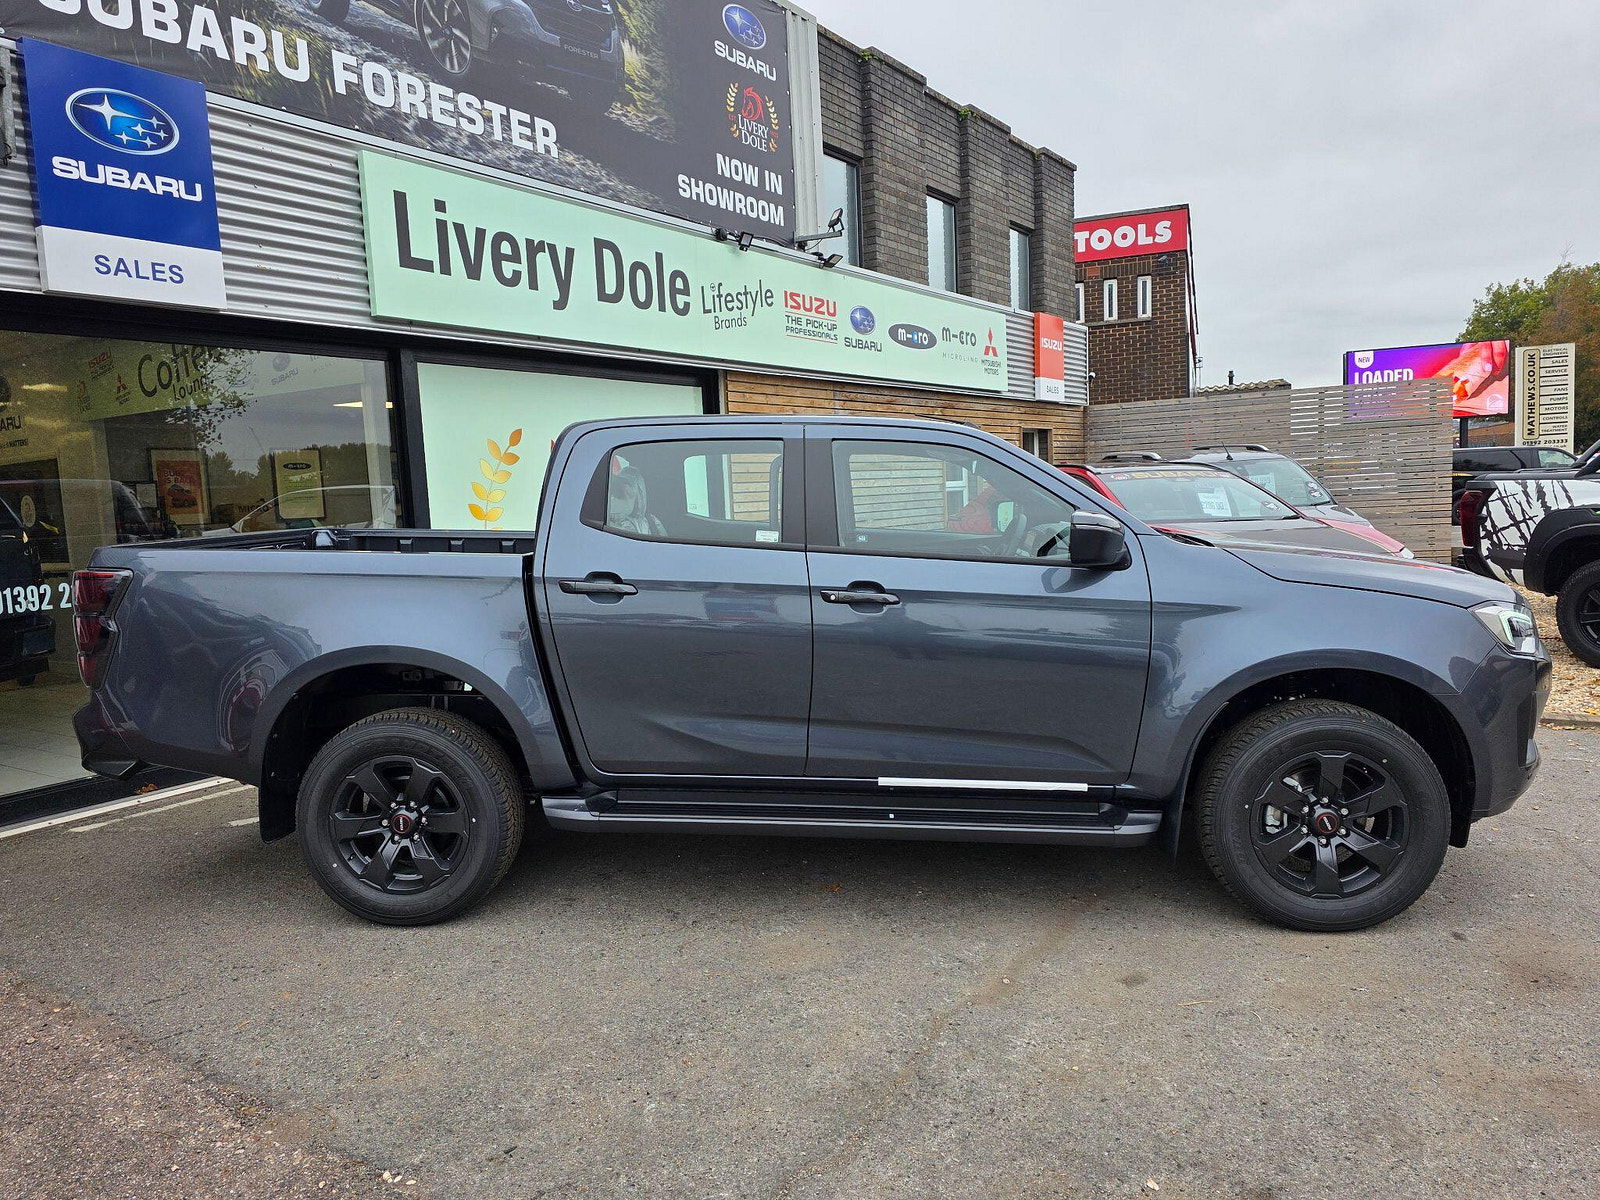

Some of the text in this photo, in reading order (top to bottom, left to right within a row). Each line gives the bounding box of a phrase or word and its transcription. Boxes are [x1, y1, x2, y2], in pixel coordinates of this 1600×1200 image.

[714, 40, 777, 81] SUBARU
[331, 50, 560, 159] FORESTER
[738, 113, 769, 139] LIVERY
[741, 130, 768, 152] DOLE
[51, 156, 203, 202] SUBARU
[716, 153, 783, 195] NOW IN
[677, 173, 785, 226] SHOWROOM
[1074, 220, 1173, 253] TOOLS
[94, 253, 185, 285] SALES
[393, 189, 692, 318] Livery Dole
[700, 279, 775, 317] Lifestyle
[783, 289, 838, 318] ISUZU
[714, 312, 748, 331] Brands
[785, 314, 838, 332] THE PICK-UP
[785, 325, 839, 341] PROFESSIONALS
[844, 336, 883, 353] SUBARU
[1041, 337, 1063, 352] ISUZU
[1046, 385, 1060, 395] SALES
[1527, 353, 1536, 436] MATHEWS.CO.UK
